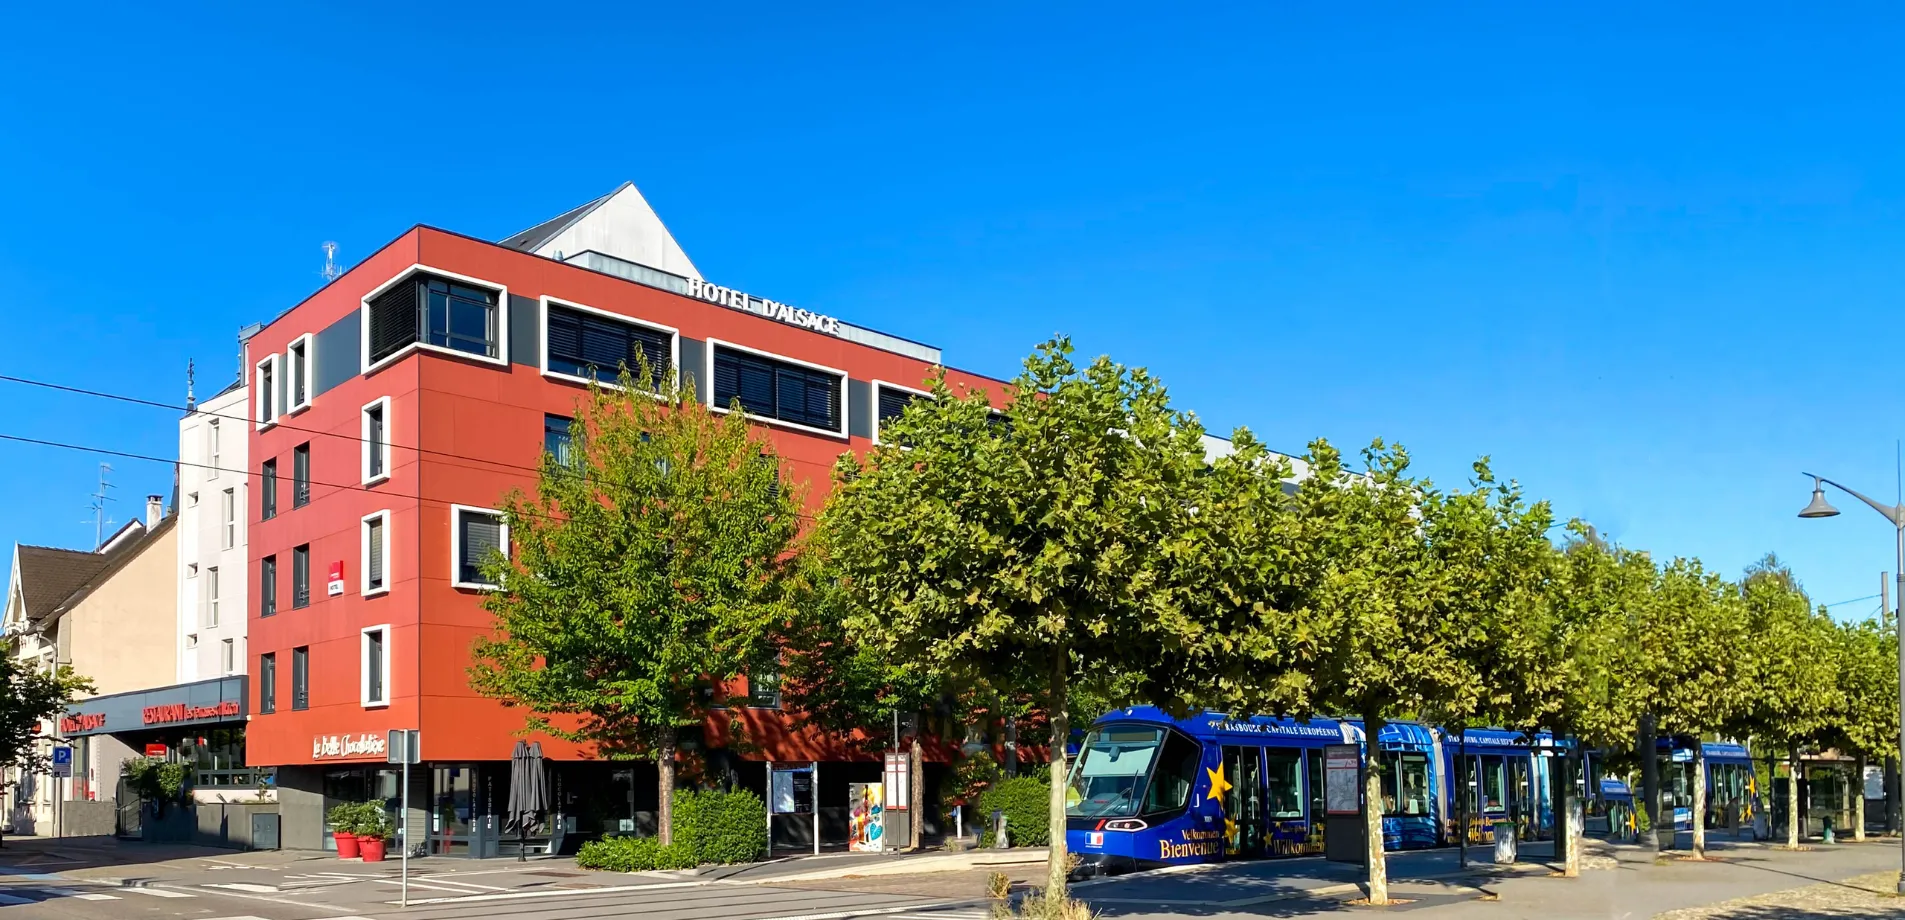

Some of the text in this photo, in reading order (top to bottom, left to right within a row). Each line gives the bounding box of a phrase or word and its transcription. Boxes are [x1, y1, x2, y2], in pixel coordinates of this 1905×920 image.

[686, 277, 839, 335] HOTEL D'ALSACE
[143, 703, 185, 724] RESTAURANT
[1216, 721, 1262, 734] SRASBOUG
[1266, 725, 1298, 736] CAPITALE
[58, 750, 67, 762] P
[1159, 839, 1220, 859] Bienvenue
